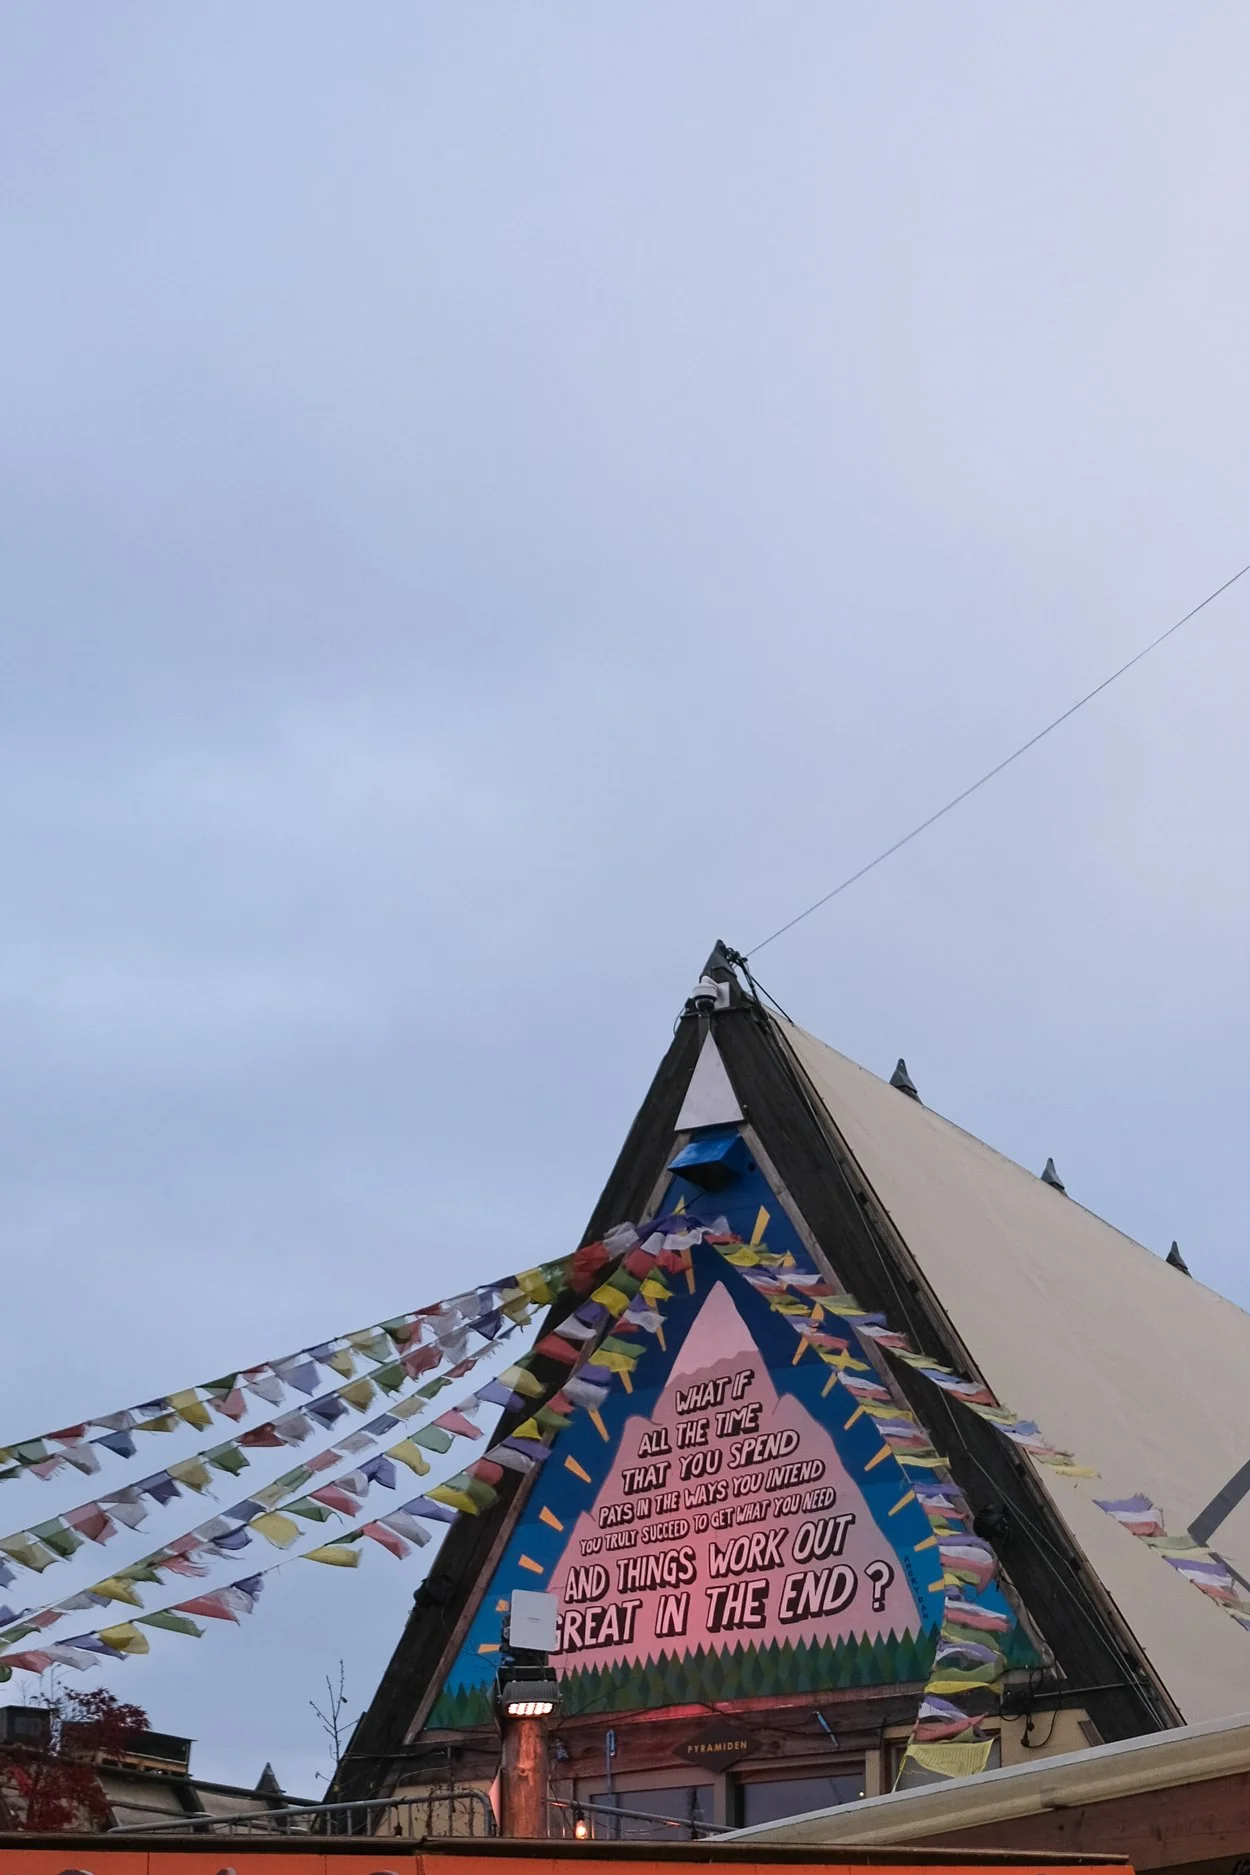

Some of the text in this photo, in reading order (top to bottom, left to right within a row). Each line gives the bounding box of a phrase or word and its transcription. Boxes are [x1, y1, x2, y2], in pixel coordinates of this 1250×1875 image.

[675, 1369, 754, 1414] WHAT IF
[637, 1402, 763, 1457] ALL THE TIME
[622, 1428, 800, 1495] THAT YOU SPEND
[579, 1486, 836, 1556] YOU TRULY SUCCEED TO GET WHAT YOU NEED
[599, 1459, 825, 1528] PAYS IN THE WAYS YOU INTEND
[564, 1513, 855, 1603] AND THINGS WORK OUT
[656, 1592, 688, 1635] IN
[705, 1579, 769, 1633] THE
[687, 1740, 748, 1754] PYRAMIDEN
